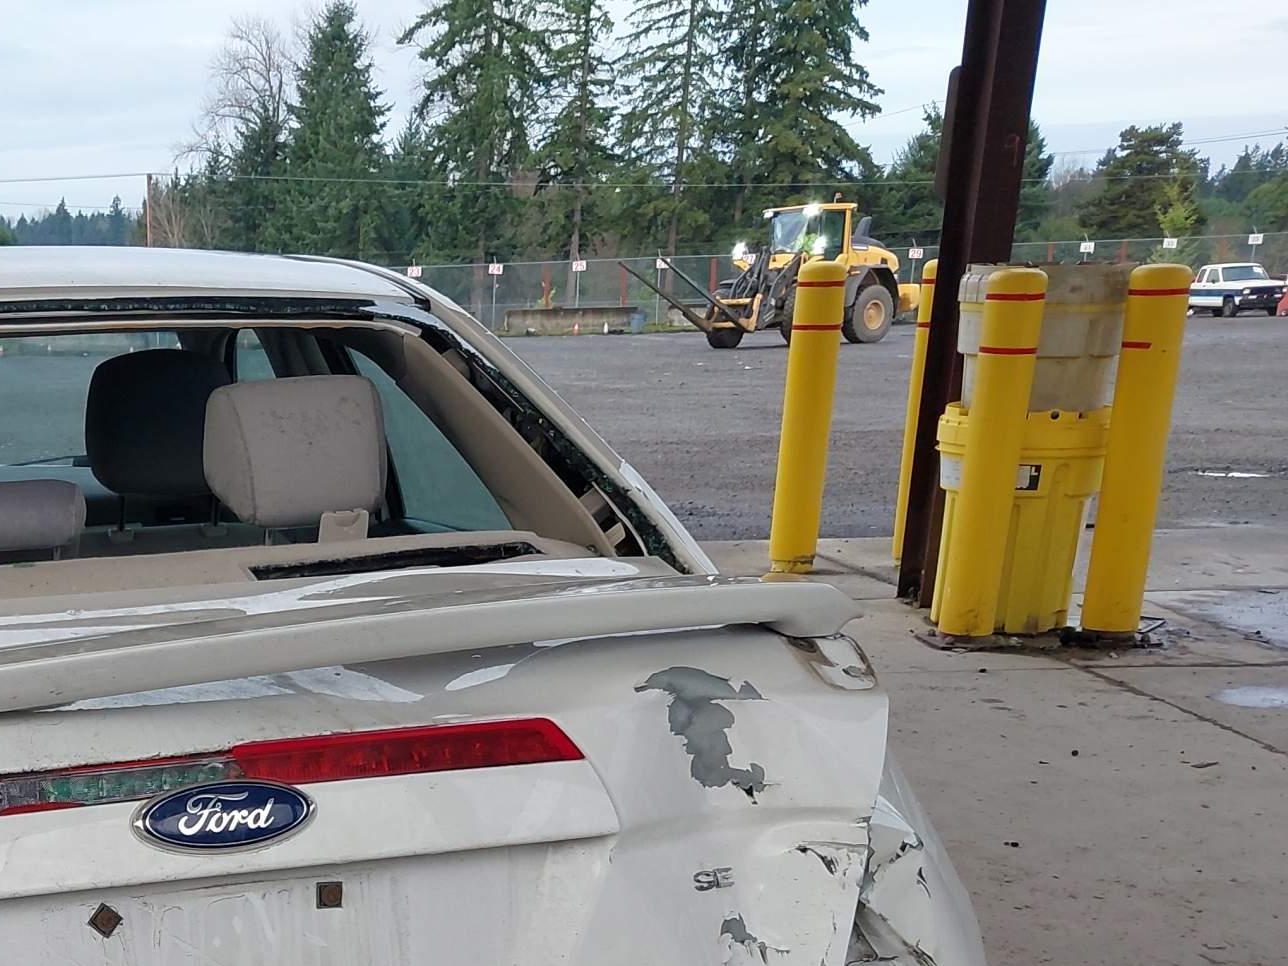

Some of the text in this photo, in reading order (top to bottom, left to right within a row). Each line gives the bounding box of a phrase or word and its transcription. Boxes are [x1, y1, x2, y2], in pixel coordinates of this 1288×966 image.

[910, 249, 922, 259] 29
[408, 266, 420, 276] 23
[489, 264, 502, 274] 24
[573, 261, 585, 271] 25
[178, 791, 274, 835] Ford
[693, 867, 735, 891] SE
